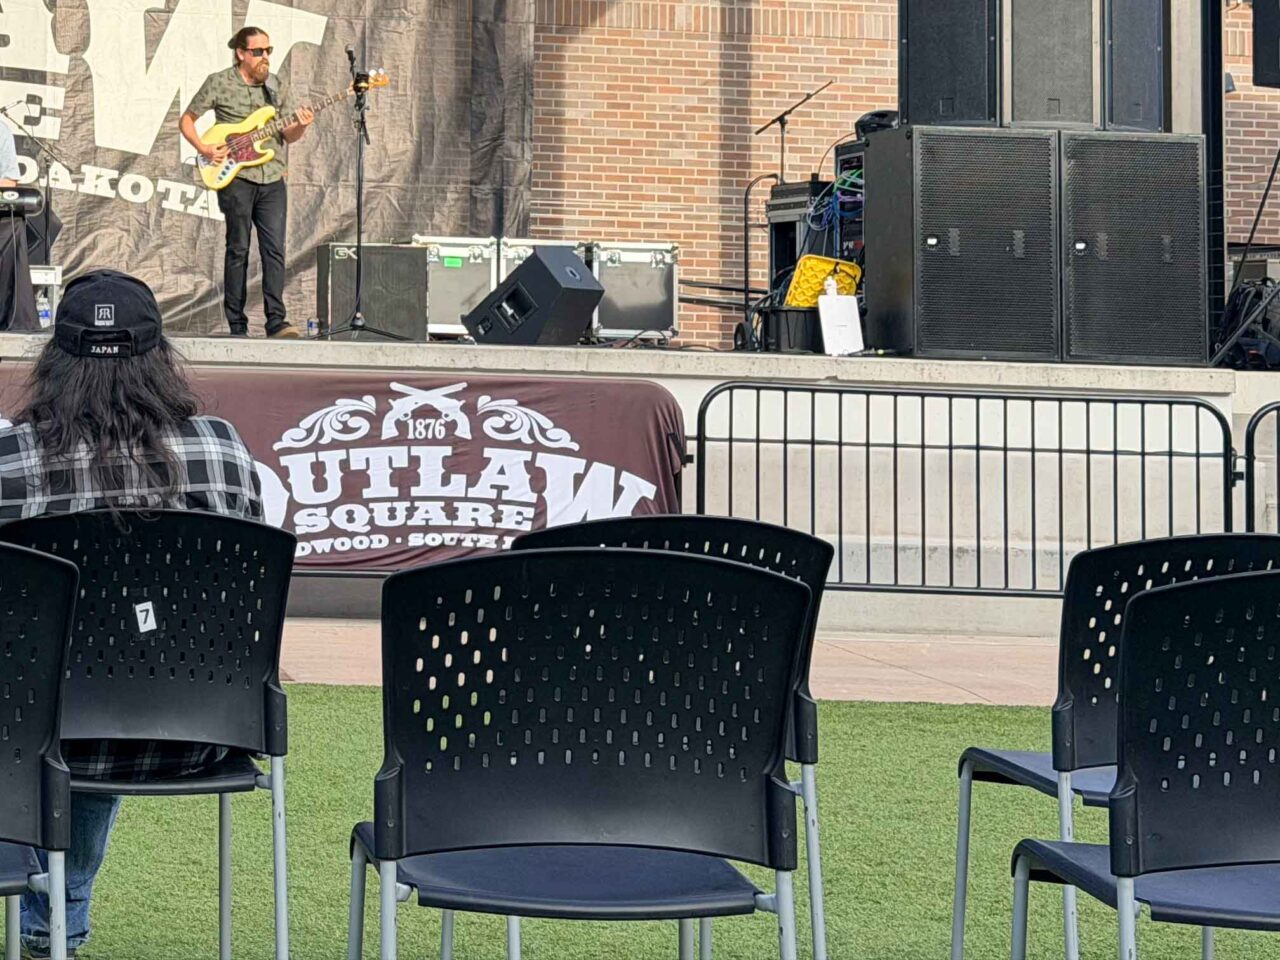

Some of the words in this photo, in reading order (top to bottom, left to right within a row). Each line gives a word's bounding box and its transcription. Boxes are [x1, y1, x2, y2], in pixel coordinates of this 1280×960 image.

[90, 345, 119, 354] JAPAN
[407, 418, 446, 439] 1876
[255, 445, 656, 528] UTLAW
[293, 501, 536, 534] SQUARE
[294, 534, 389, 557] DWOOD
[408, 533, 498, 549] SOUTH
[139, 608, 150, 625] 7
